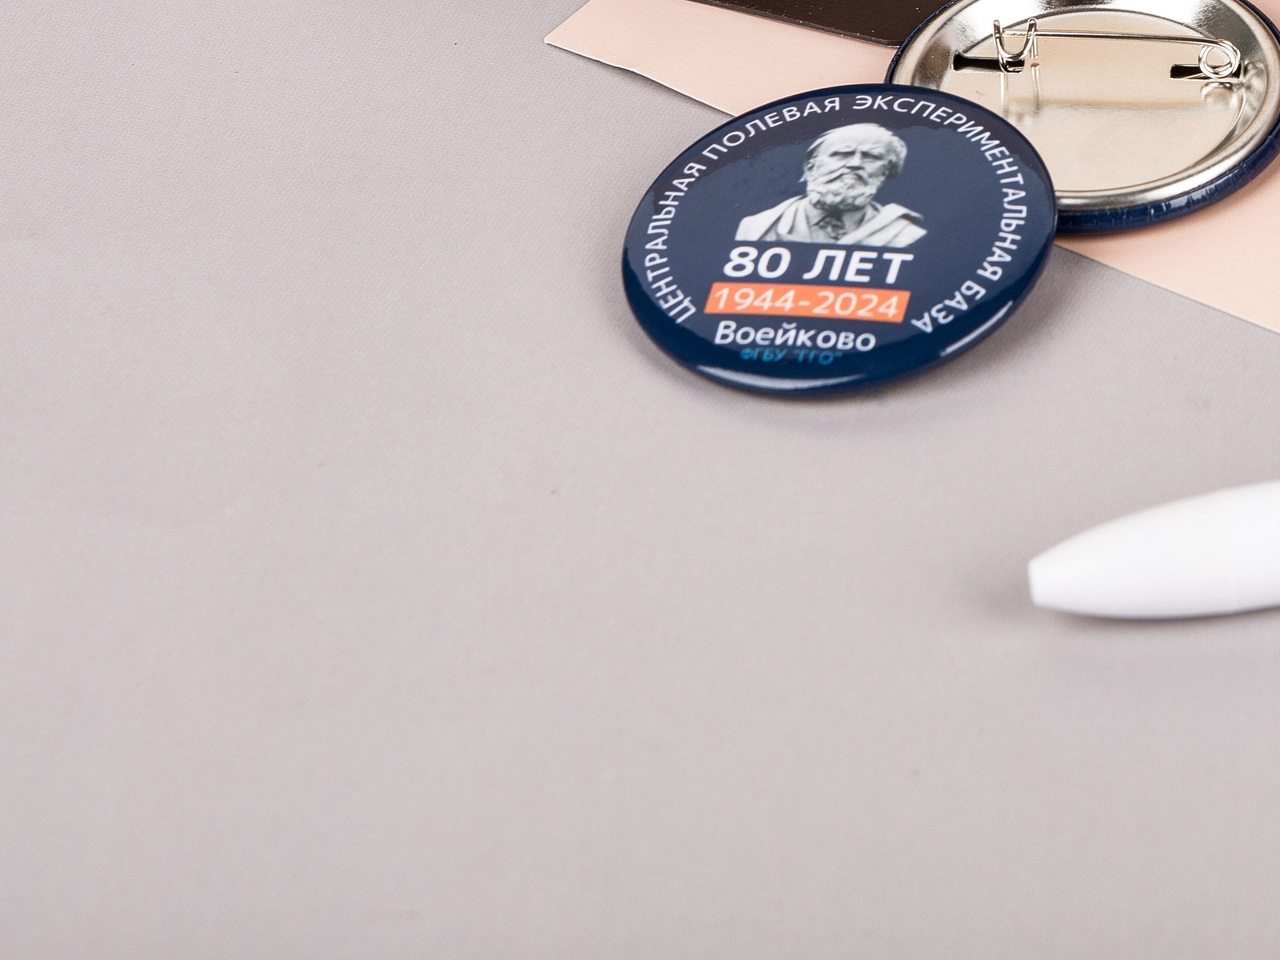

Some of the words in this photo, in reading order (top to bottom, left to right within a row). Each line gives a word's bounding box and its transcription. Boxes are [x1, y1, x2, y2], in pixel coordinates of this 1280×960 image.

[703, 97, 841, 160] ПОЛЕВАЯ
[852, 94, 1027, 282] ЭКСПЕРИМЕНТАЛЬНАЯ
[645, 162, 706, 324] ЦЕНТРАЛЬНАЯ
[723, 247, 790, 278] 80
[802, 250, 914, 284] ЛЕТ
[713, 287, 899, 318] 1944-2024
[912, 280, 986, 333] БАЗА
[714, 321, 876, 352] Воейково
[739, 348, 787, 362] ФГБУ
